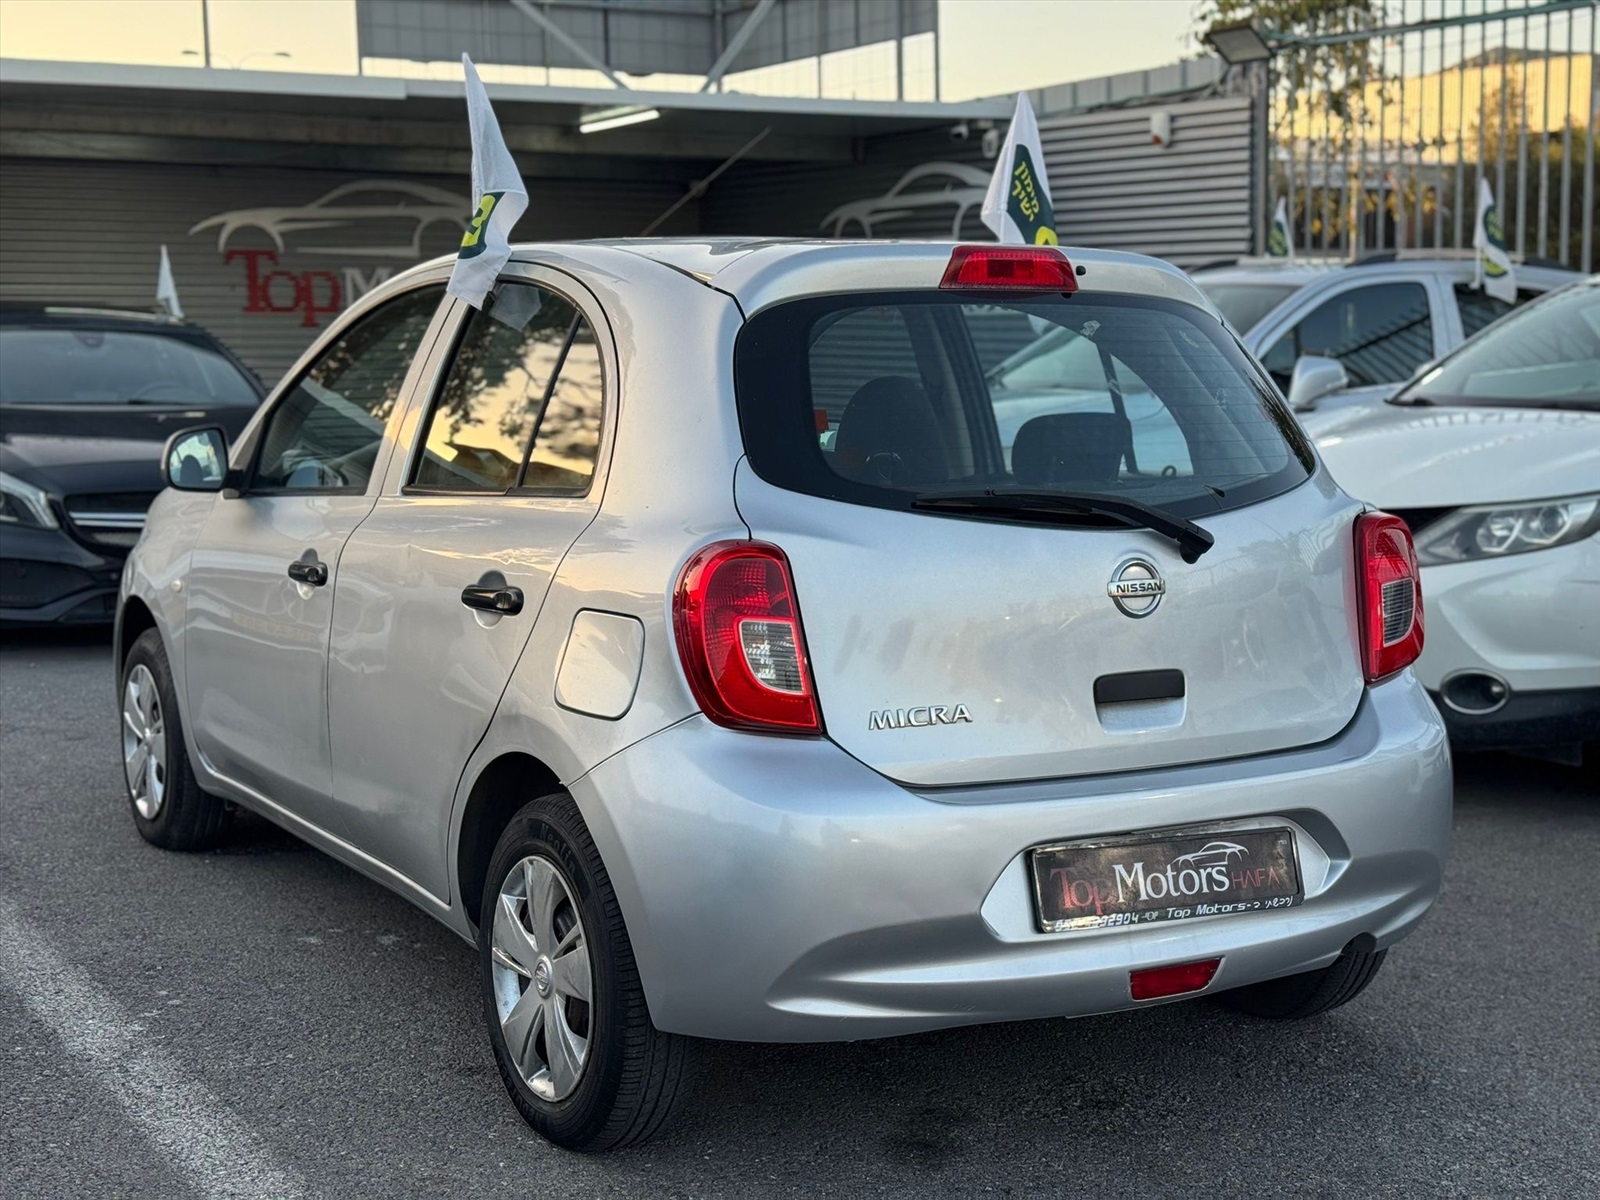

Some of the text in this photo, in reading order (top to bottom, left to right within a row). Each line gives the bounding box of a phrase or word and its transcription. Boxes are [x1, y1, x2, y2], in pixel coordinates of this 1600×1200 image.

[223, 249, 341, 328] Top
[1116, 582, 1162, 594] NISSAN
[868, 703, 973, 731] MICRA
[1049, 867, 1111, 916] Top
[1112, 862, 1230, 904] Motors
[1166, 907, 1191, 919] Top
